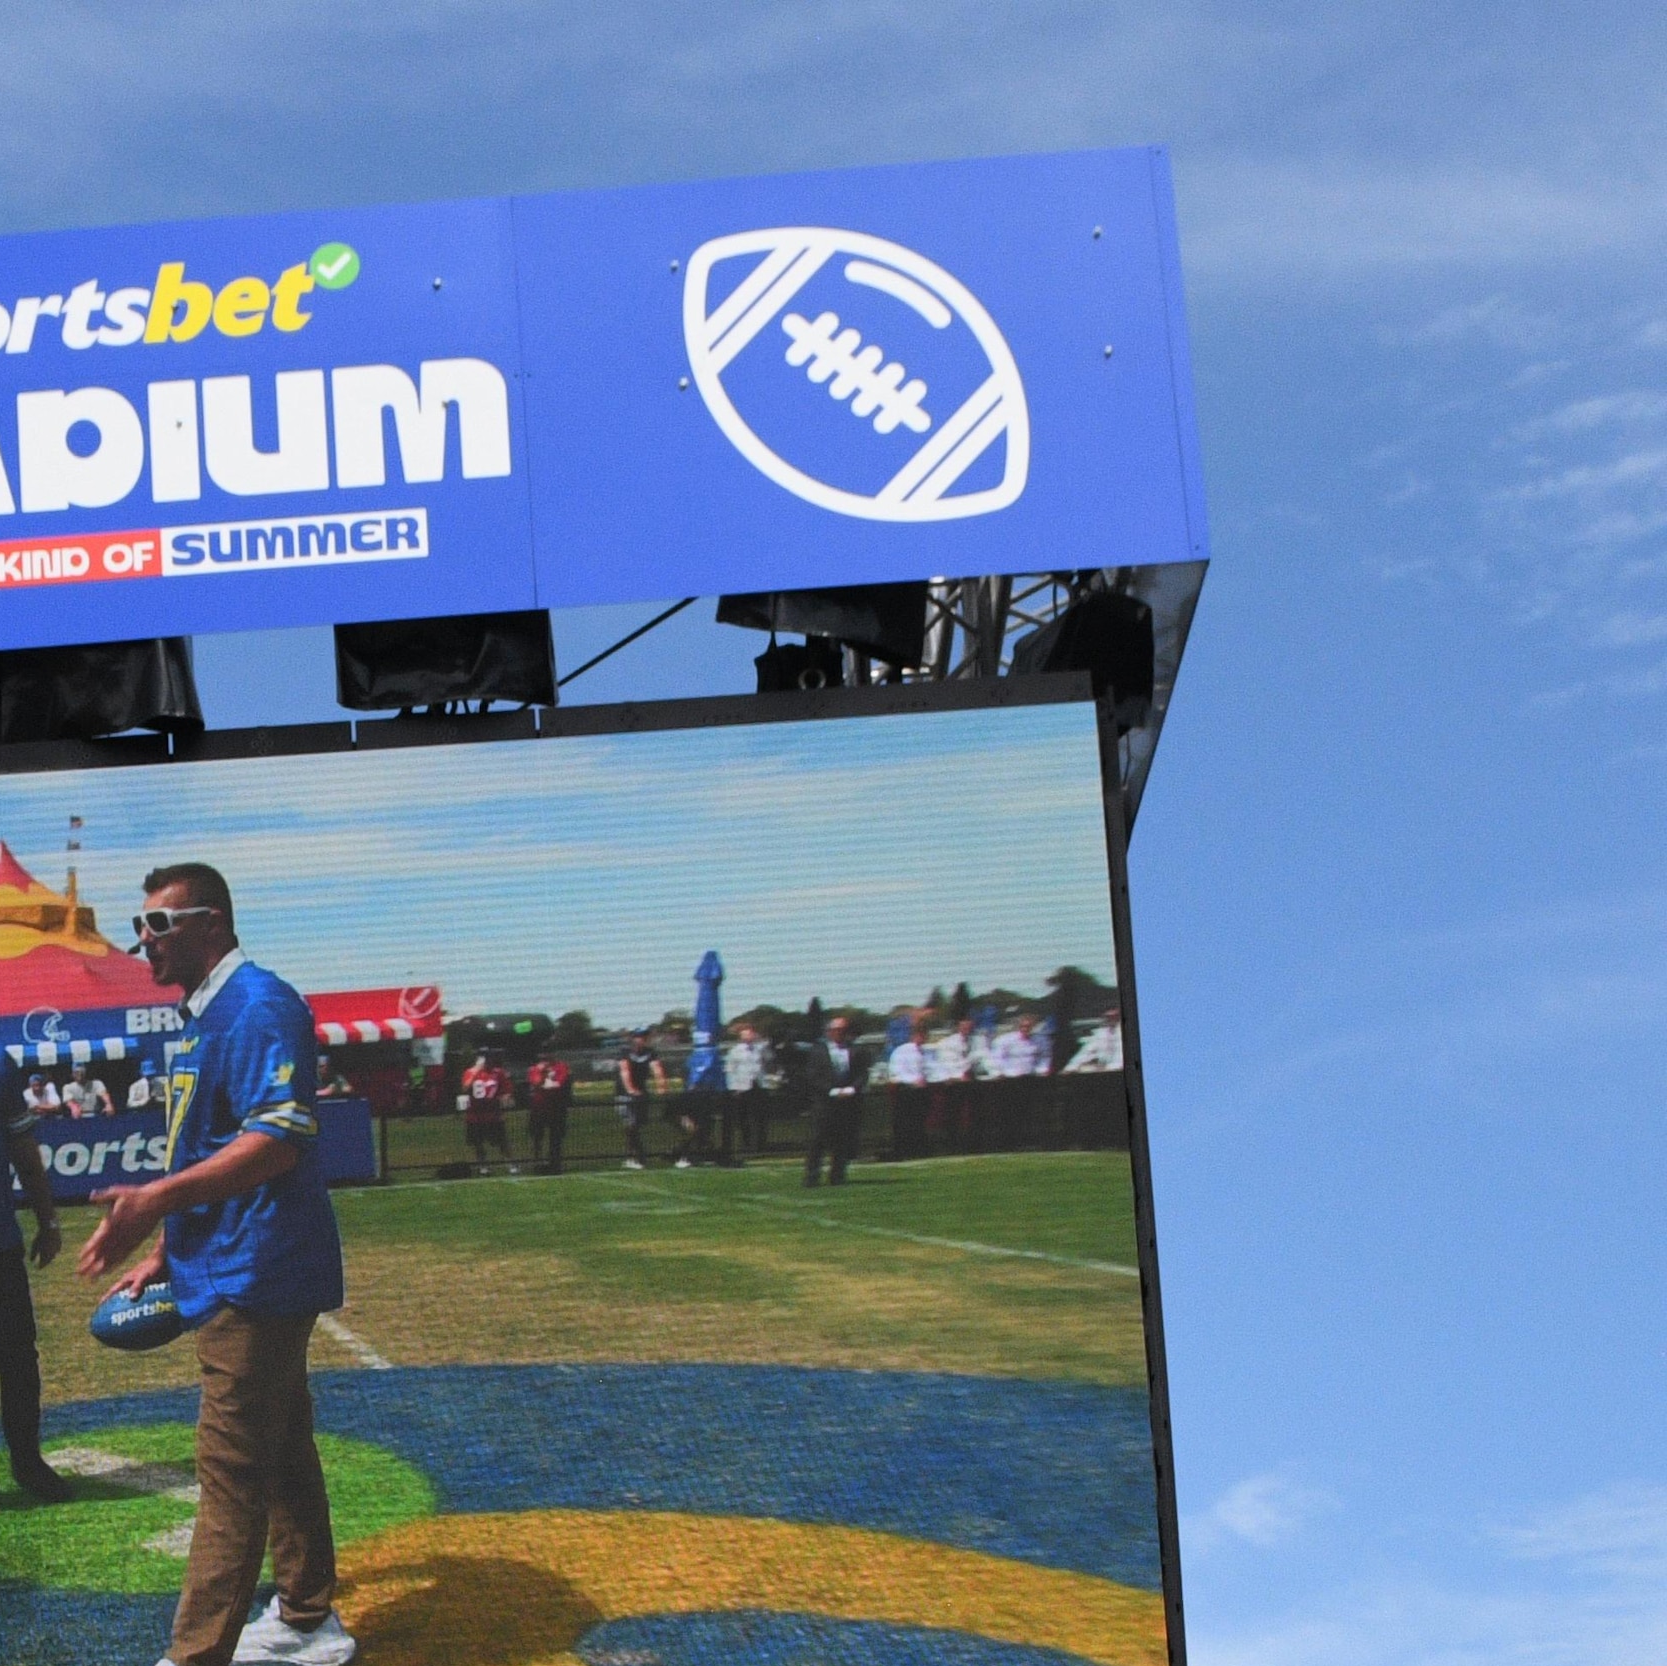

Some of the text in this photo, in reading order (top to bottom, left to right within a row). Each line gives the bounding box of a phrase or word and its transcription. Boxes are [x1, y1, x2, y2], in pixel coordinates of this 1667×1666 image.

[102, 541, 156, 575] OF
[170, 518, 421, 566] SUMMER
[111, 1301, 175, 1326] sportsbe
